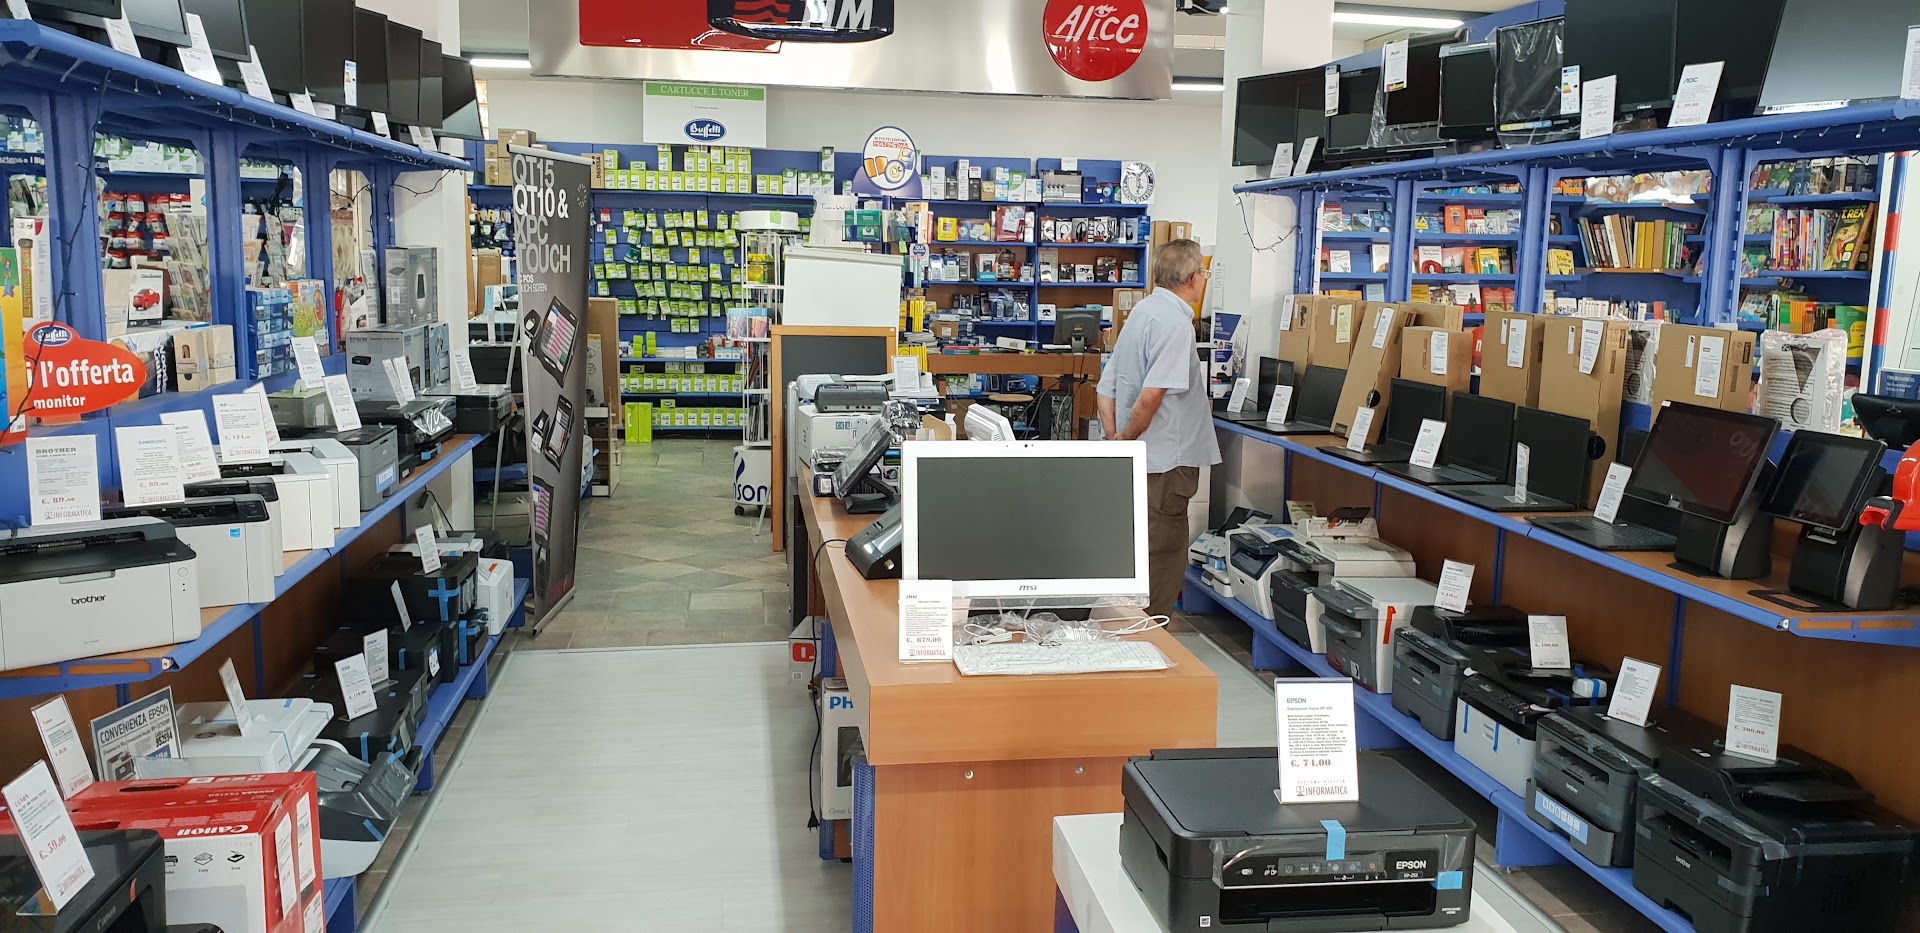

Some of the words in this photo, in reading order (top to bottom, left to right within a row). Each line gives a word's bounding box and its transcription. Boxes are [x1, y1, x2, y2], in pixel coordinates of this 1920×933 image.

[1054, 4, 1140, 44] Alice
[660, 85, 709, 95] CARTUCCE
[711, 87, 717, 96] E
[719, 88, 750, 98] TONER
[513, 154, 555, 188] QT15
[513, 184, 555, 218] QT10
[557, 188, 569, 219] &
[514, 215, 549, 246] XPC
[517, 243, 571, 274] TOUCH
[22, 270, 32, 317] ELECTRONIC
[33, 394, 86, 409] monitor
[53, 509, 93, 519] INFORMATICA
[70, 594, 107, 605] brother
[915, 649, 946, 657] INFORMATICA
[100, 712, 148, 744] CONVENIENZA
[148, 702, 169, 721] EPSON
[1741, 743, 1770, 754] INFORMATICA
[1305, 785, 1348, 797] INFORMATICA
[1565, 782, 1579, 794] brother
[14, 793, 29, 808] CANON
[176, 824, 249, 837] Canon
[1396, 860, 1427, 870] EPSON
